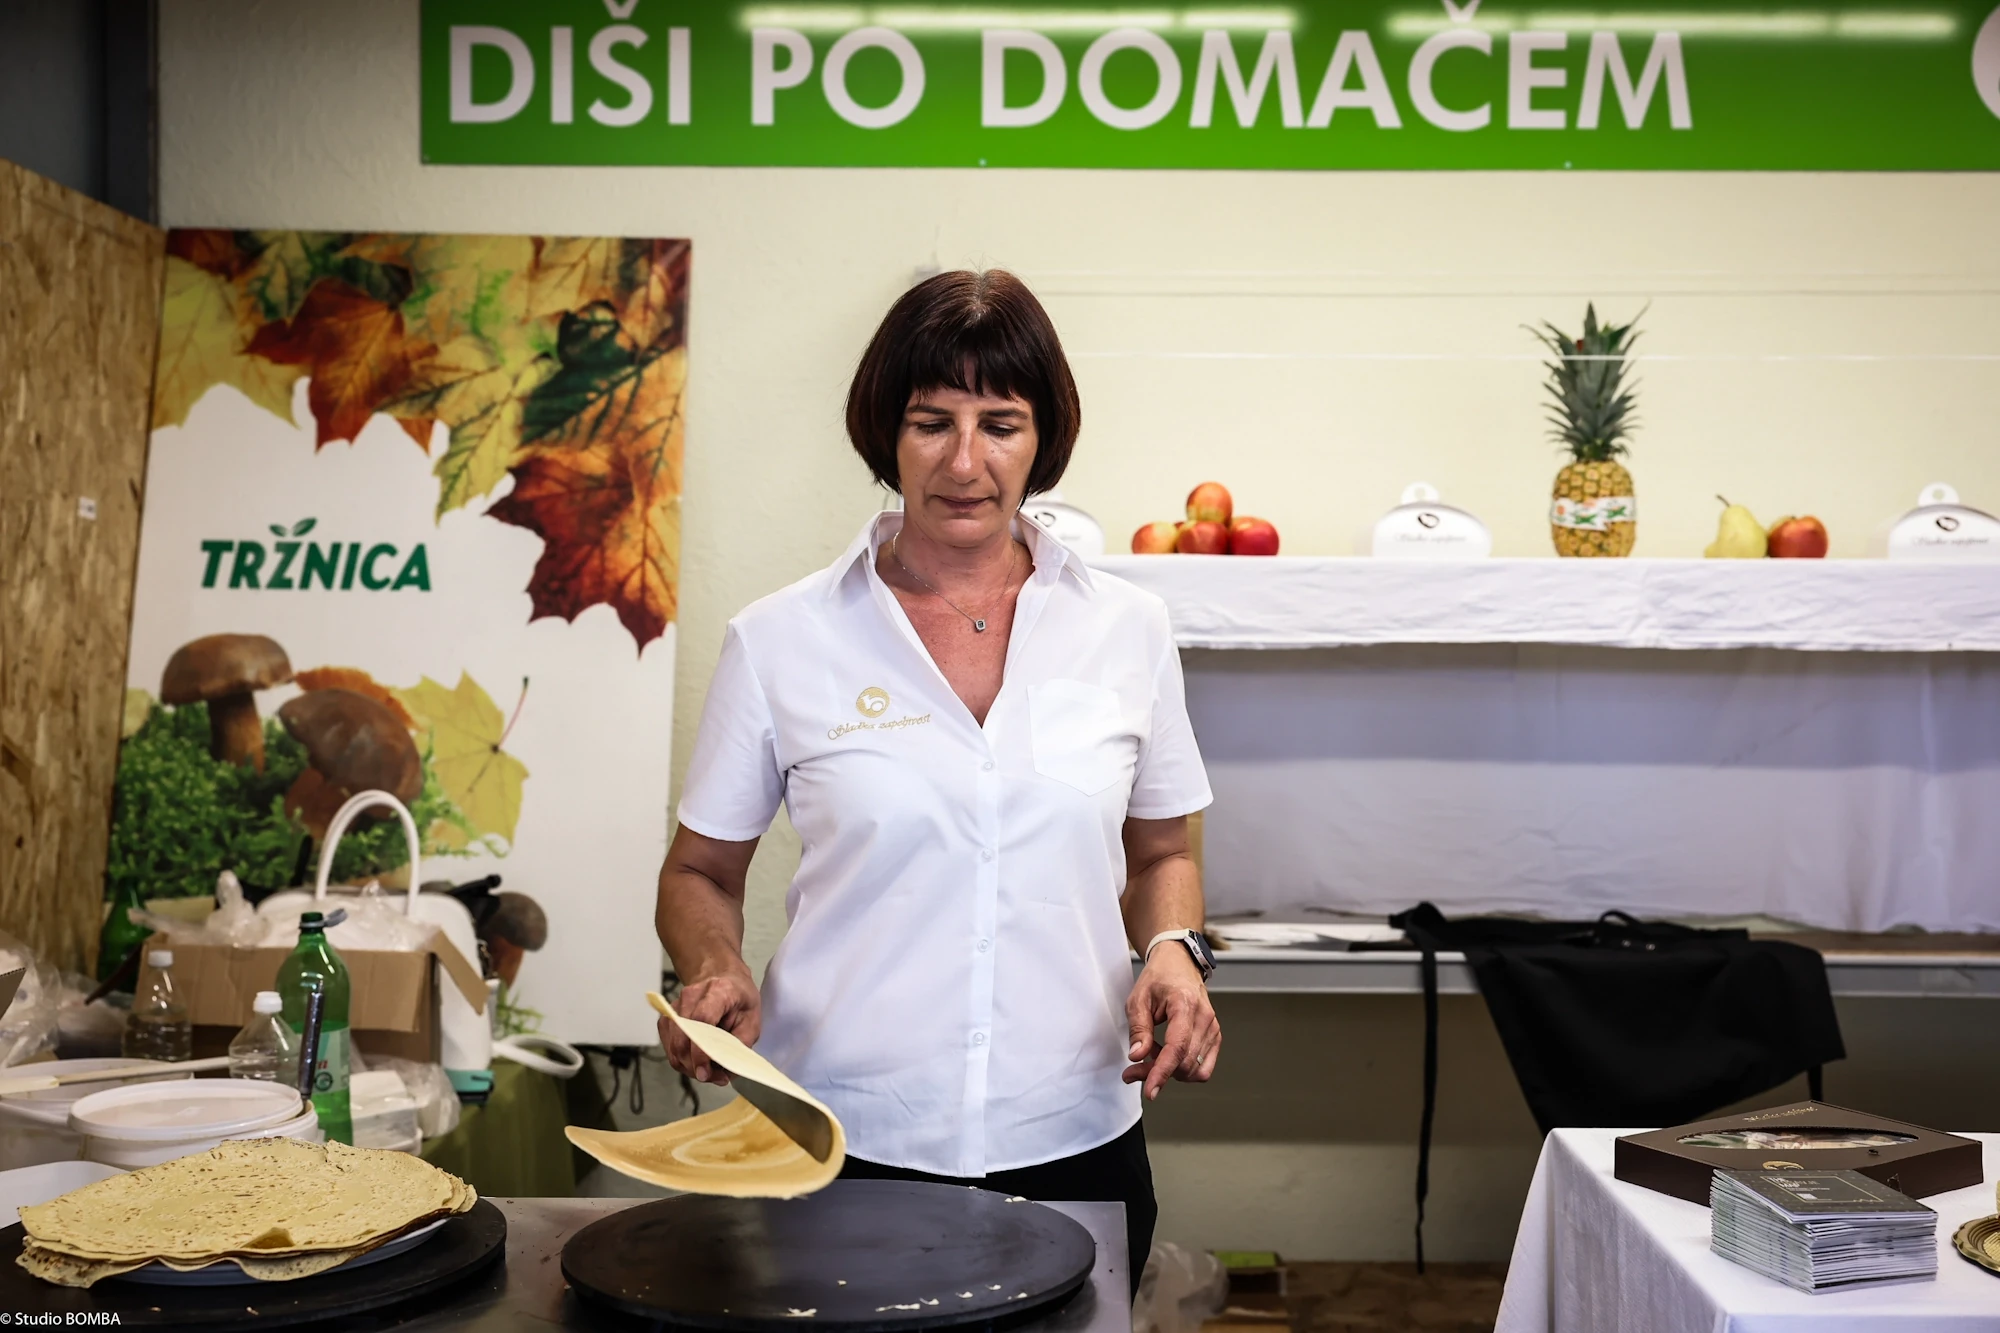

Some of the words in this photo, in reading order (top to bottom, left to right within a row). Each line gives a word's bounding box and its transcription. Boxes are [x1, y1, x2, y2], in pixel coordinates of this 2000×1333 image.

[449, 0, 691, 127] DIŠI
[750, 26, 926, 129] PO
[981, 0, 1693, 131] DOMAČEM
[200, 517, 432, 592] TRŽNICA
